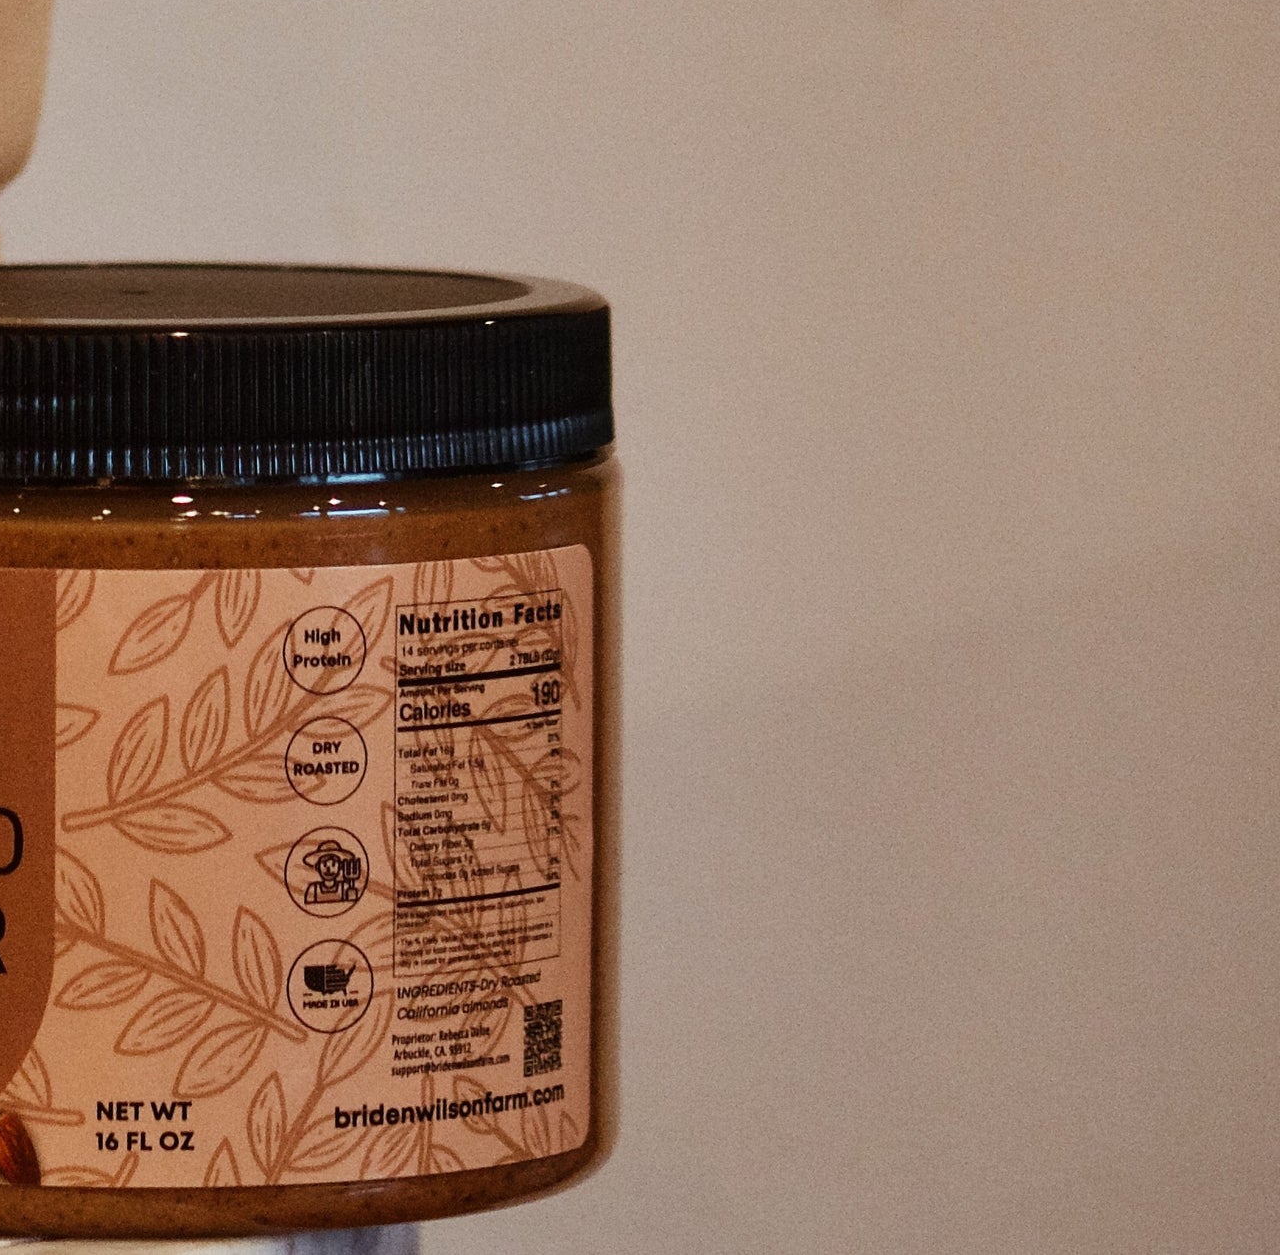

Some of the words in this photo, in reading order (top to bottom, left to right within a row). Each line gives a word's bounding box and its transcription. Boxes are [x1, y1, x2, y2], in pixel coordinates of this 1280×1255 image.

[399, 608, 503, 635] Nutrition
[514, 600, 561, 624] Facts
[304, 628, 341, 646] High
[293, 652, 351, 669] Protein
[399, 663, 442, 677] Serving
[445, 661, 466, 672] size
[454, 683, 485, 694] Serving
[399, 698, 471, 722] Calories
[532, 679, 561, 706] 190
[312, 742, 342, 755] DRY
[398, 748, 421, 758] Total
[293, 760, 360, 776] ROASTED
[398, 793, 449, 806] Cholesterol
[398, 810, 432, 821] Sodium
[398, 827, 420, 837] Total
[423, 822, 479, 836] Carbohydrate
[303, 999, 328, 1010] MADE
[397, 1003, 460, 1020] California
[462, 997, 509, 1013] almonds
[96, 1101, 144, 1121] NET
[150, 1101, 192, 1121] WT
[334, 1084, 564, 1129] bridenwilsonfarm.com
[96, 1132, 118, 1151] 16
[127, 1131, 152, 1151] FL
[159, 1131, 195, 1151] OZ
